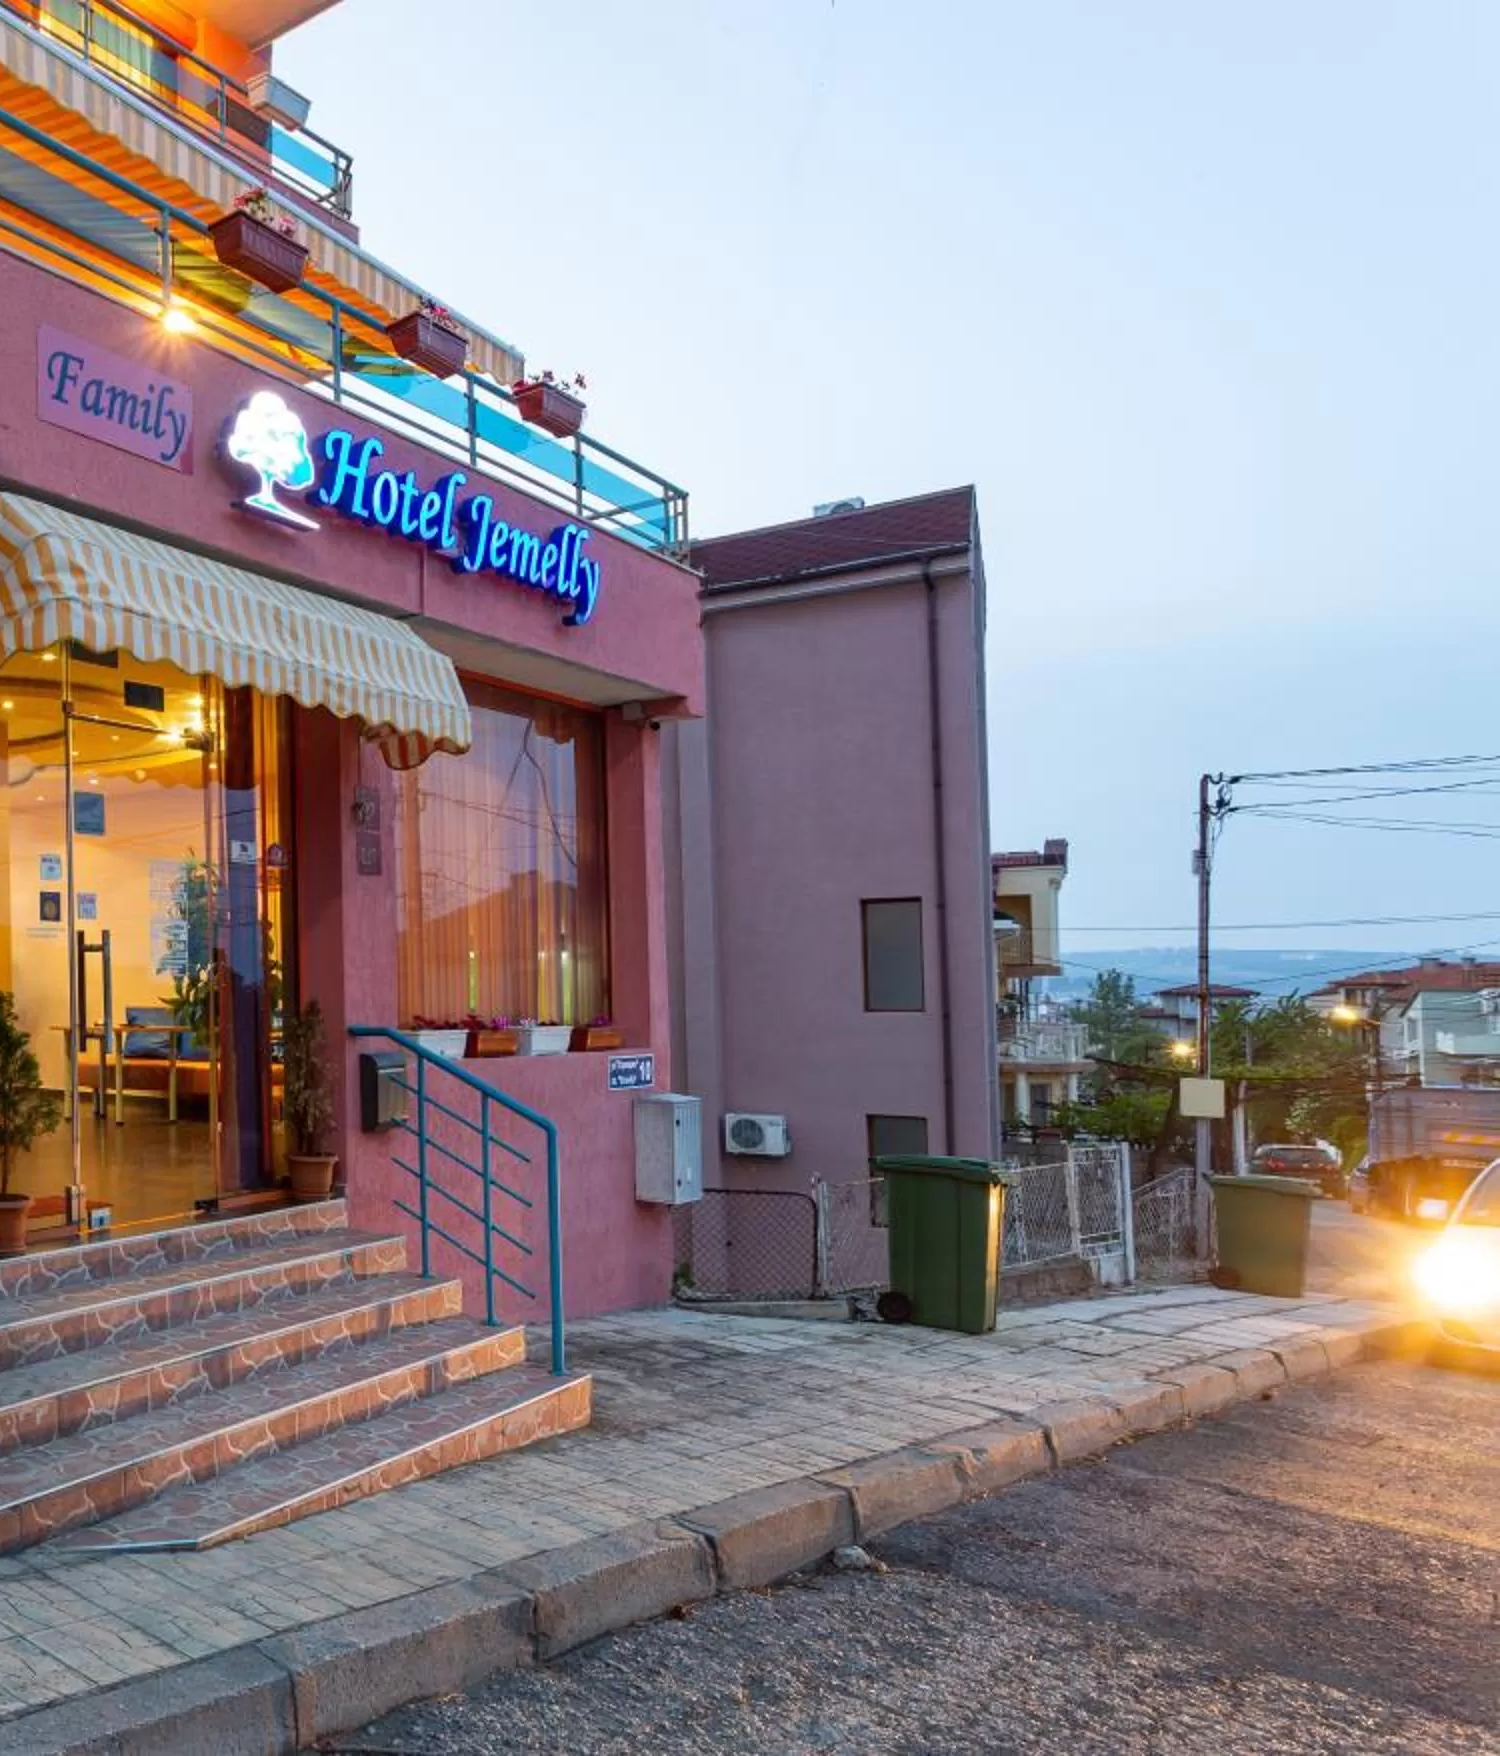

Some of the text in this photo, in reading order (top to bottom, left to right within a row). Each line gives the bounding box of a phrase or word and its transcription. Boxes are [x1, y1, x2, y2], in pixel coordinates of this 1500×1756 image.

[47, 351, 187, 462] Family
[319, 430, 600, 625] Hotel Jemelly
